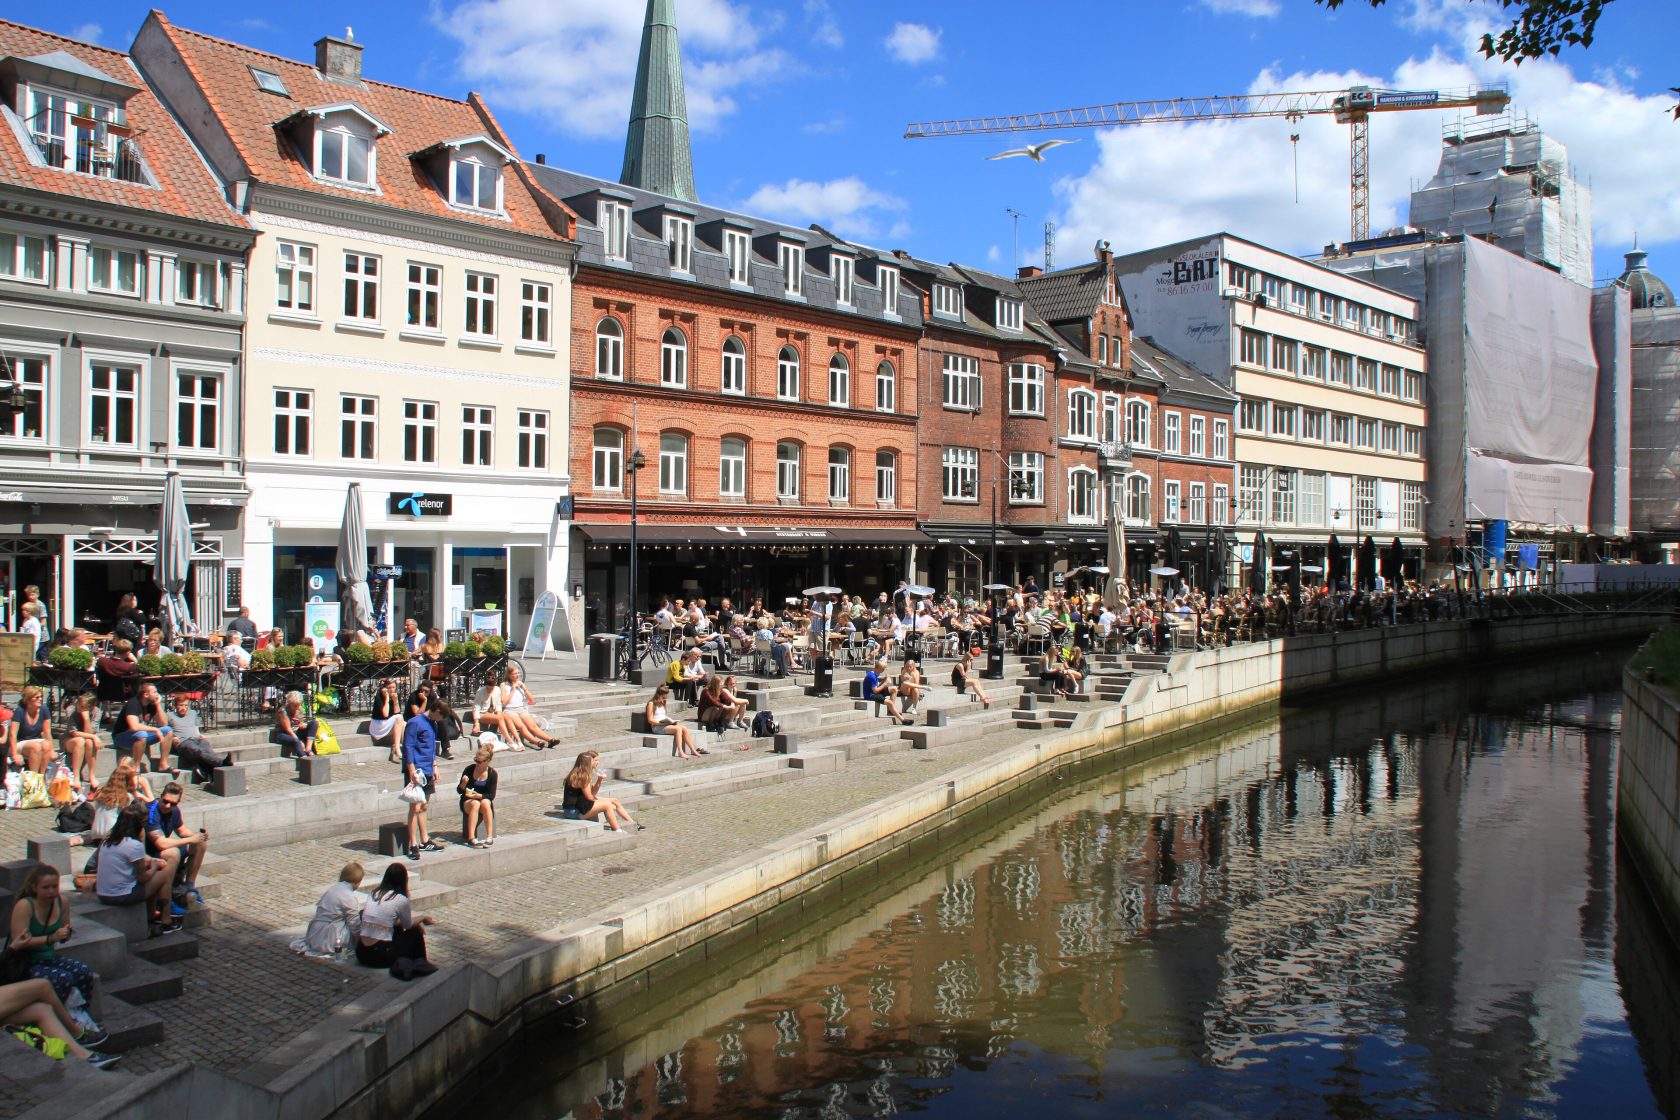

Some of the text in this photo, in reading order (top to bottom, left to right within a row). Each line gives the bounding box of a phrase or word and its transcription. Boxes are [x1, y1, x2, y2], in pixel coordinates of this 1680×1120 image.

[1351, 92, 1373, 100] EC-B
[1167, 287, 1177, 296] 86
[1191, 284, 1200, 292] 57
[417, 498, 444, 508] telenor
